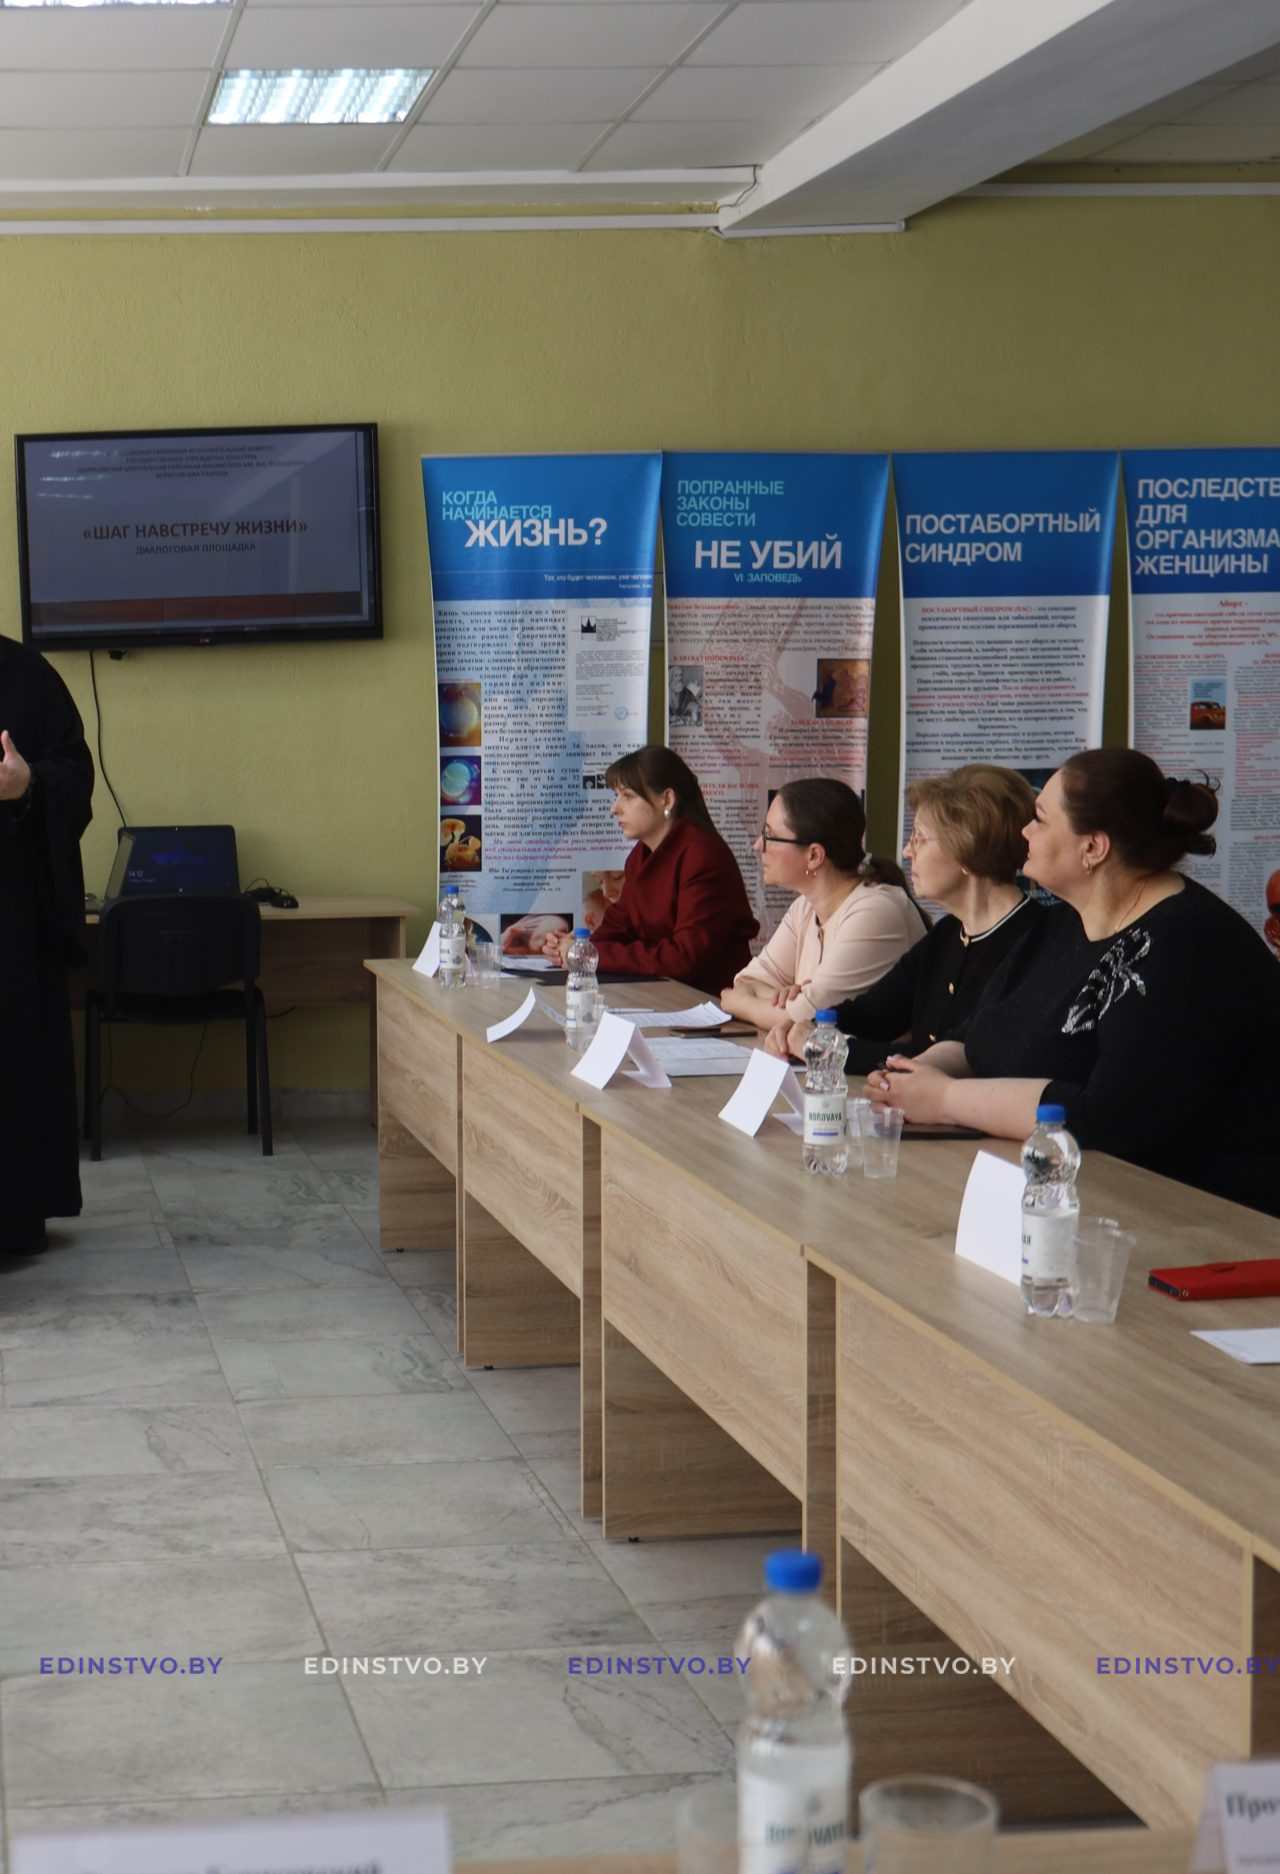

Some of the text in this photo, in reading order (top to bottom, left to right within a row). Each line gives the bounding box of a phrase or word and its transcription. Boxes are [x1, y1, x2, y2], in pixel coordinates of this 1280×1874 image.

[678, 480, 784, 495] ПОПРАННЫЕ
[1138, 477, 1280, 501] ПОСЛЕДСТВ
[442, 490, 498, 506] КОГДА
[676, 496, 750, 510] ЗАКОНЫ
[442, 505, 552, 520] НАЧИНАЕТСЯ
[676, 512, 756, 527] СОВЕСТИ
[905, 507, 1100, 534] ПОСТАБОРТНЫЙ
[1136, 504, 1187, 528] ДЛЯ
[83, 520, 308, 540] «ШАГ НАВСТРЕЧУ ЖИЗНИ»
[464, 517, 608, 548] ЖИЗНЬ?
[1136, 528, 1280, 550] ОРГАНИЗМА
[136, 543, 256, 556] ДИАЛОГОВАЯ ПЛОЩАДКА
[694, 533, 842, 570] НЕ УБИЙ
[905, 542, 1022, 566] СИНДРОМ
[1136, 554, 1268, 578] ЖЕНЩИНЫ
[734, 573, 802, 584] VI ЗАПОВЕДЬ
[808, 1112, 842, 1122] BOROVAYA
